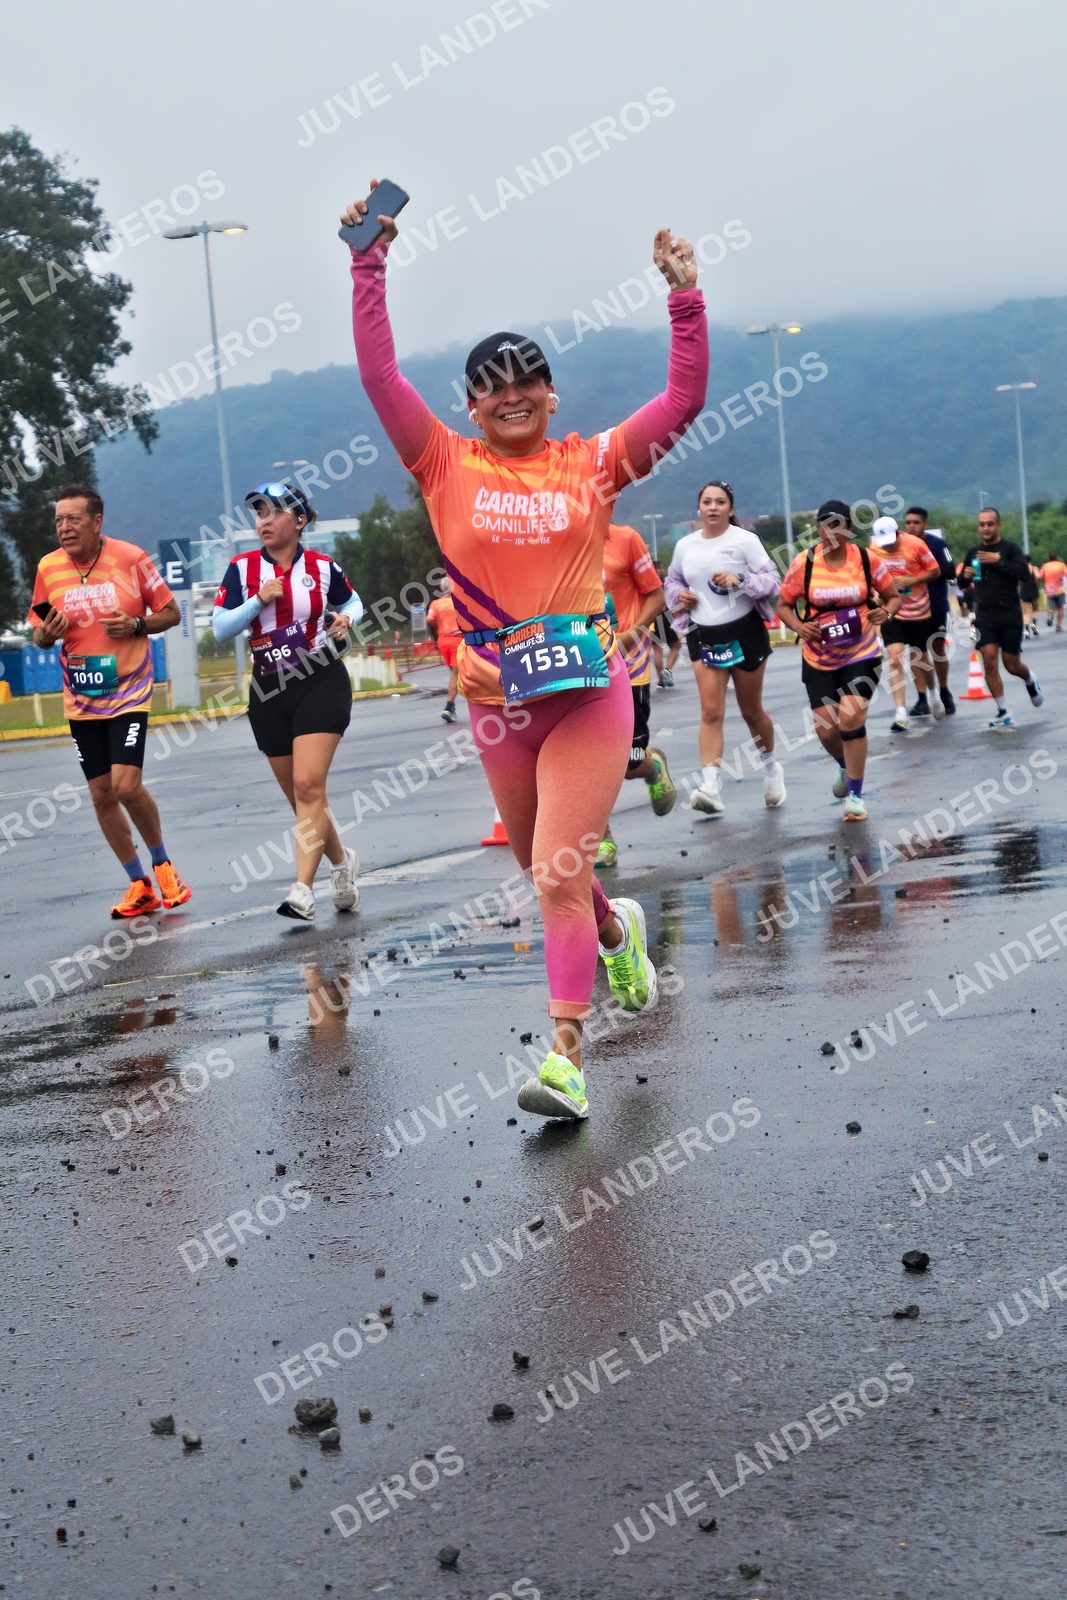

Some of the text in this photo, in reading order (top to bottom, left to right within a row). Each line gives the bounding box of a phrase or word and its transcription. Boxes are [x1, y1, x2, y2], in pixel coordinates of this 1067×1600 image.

[475, 486, 568, 516] CARRERA
[472, 513, 548, 534] OMNILIFE
[166, 561, 184, 583] E
[285, 624, 298, 637] 15K
[504, 622, 545, 648] CARRERA
[570, 620, 588, 636] 10K
[828, 623, 851, 638] 531
[264, 644, 292, 663] 196
[504, 637, 536, 655] OMNILIFE
[707, 648, 733, 661] 1486
[520, 645, 583, 675] 1531
[73, 671, 104, 684] 1010
